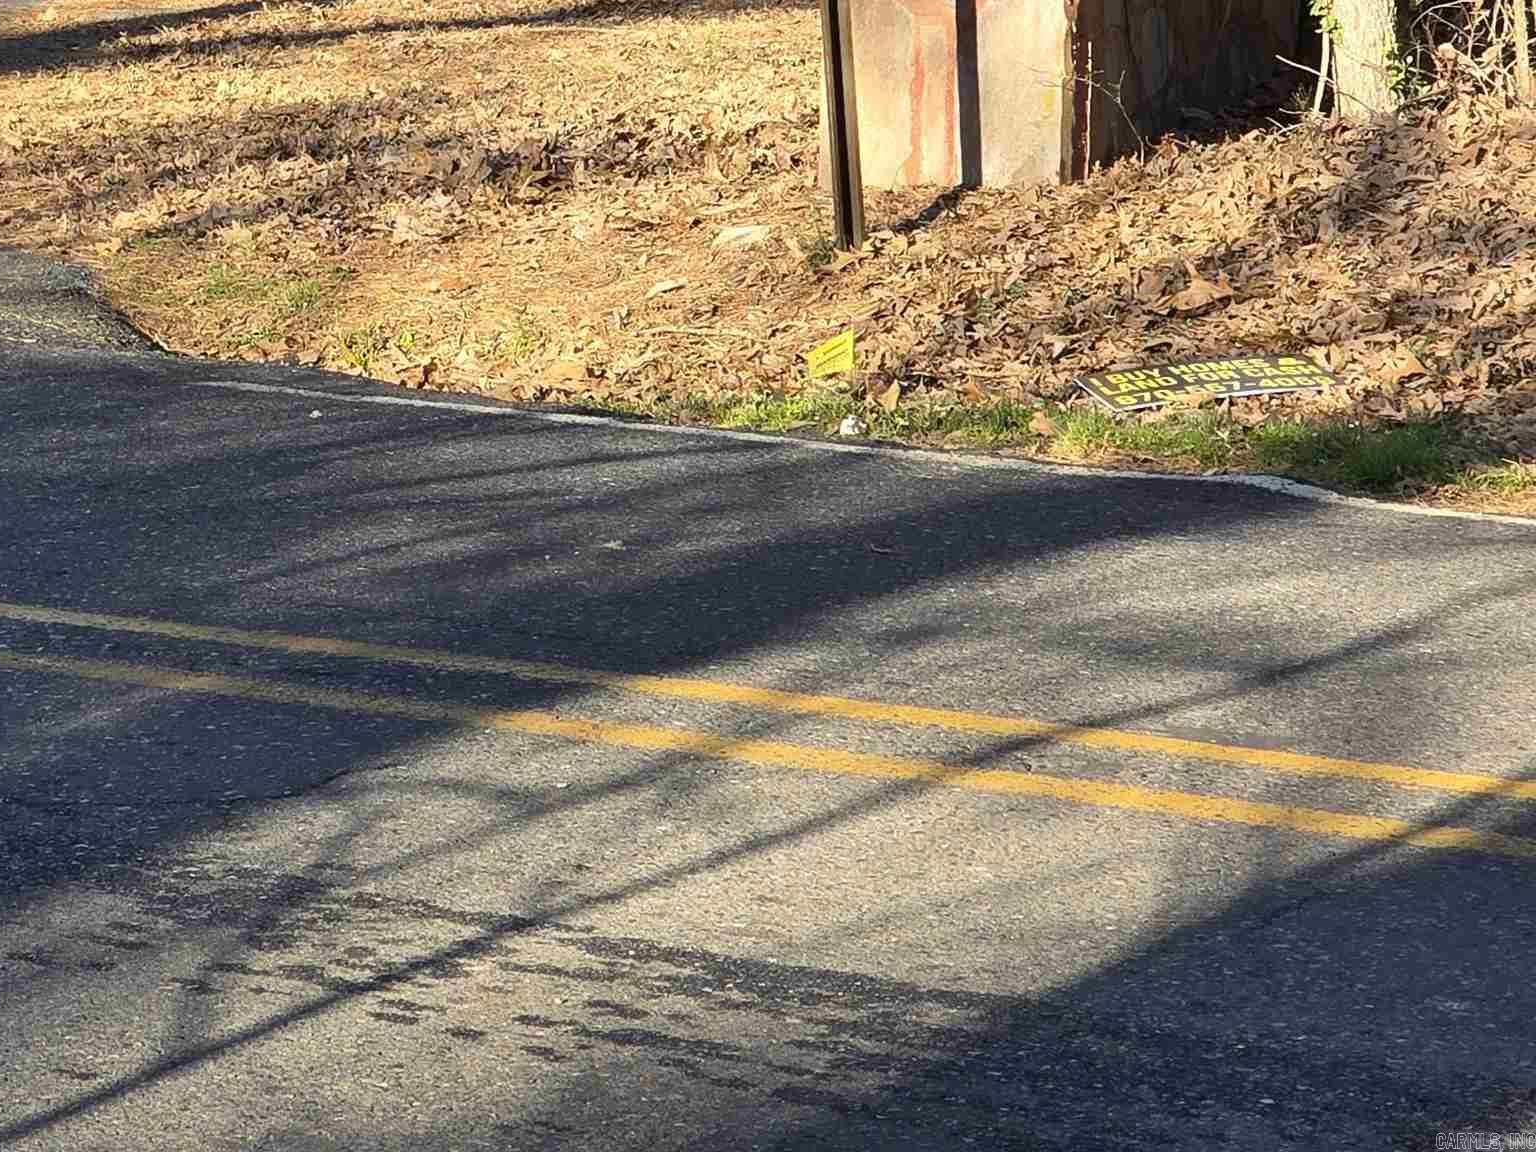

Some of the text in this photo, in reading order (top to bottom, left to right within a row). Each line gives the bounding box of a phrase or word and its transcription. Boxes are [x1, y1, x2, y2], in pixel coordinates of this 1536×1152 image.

[1088, 378, 1104, 387] I
[1105, 368, 1161, 384] BUY
[1168, 358, 1271, 375] HOMES
[1100, 364, 1323, 396] LAND FOR CASH
